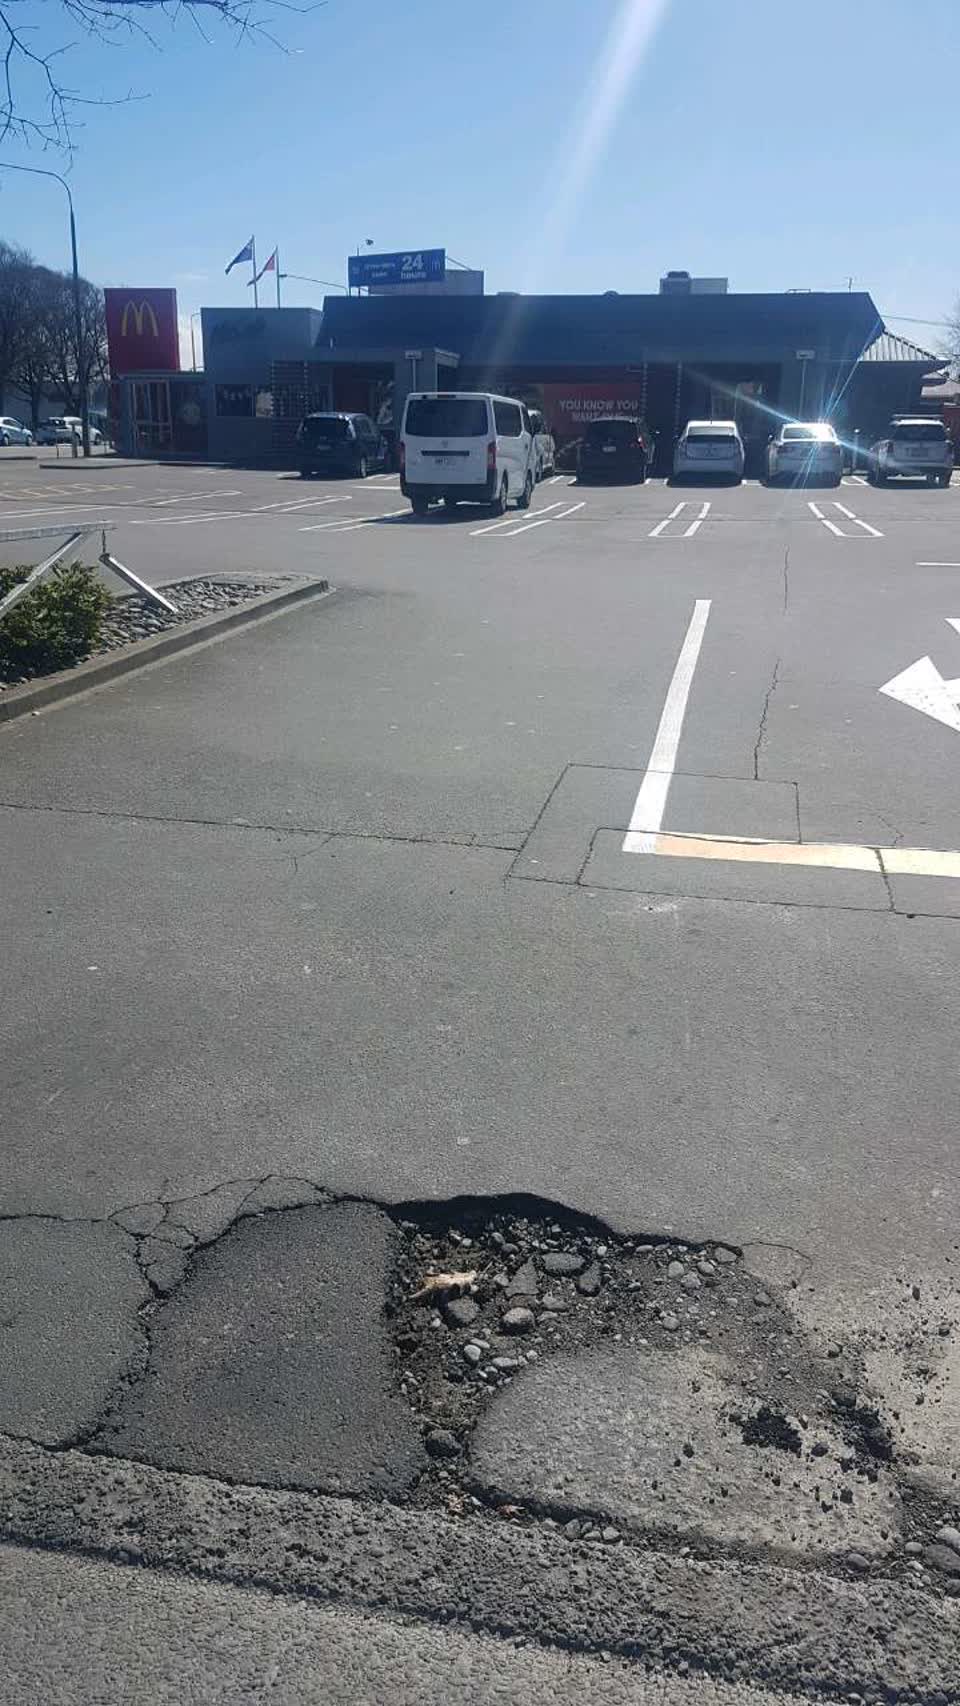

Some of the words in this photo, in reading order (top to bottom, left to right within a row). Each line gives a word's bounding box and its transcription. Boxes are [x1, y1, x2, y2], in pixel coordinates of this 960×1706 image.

[402, 254, 424, 271] 24
[400, 270, 427, 280] hours
[559, 399, 581, 411] YOU
[583, 399, 615, 411] KNOW
[616, 399, 639, 411] YOU
